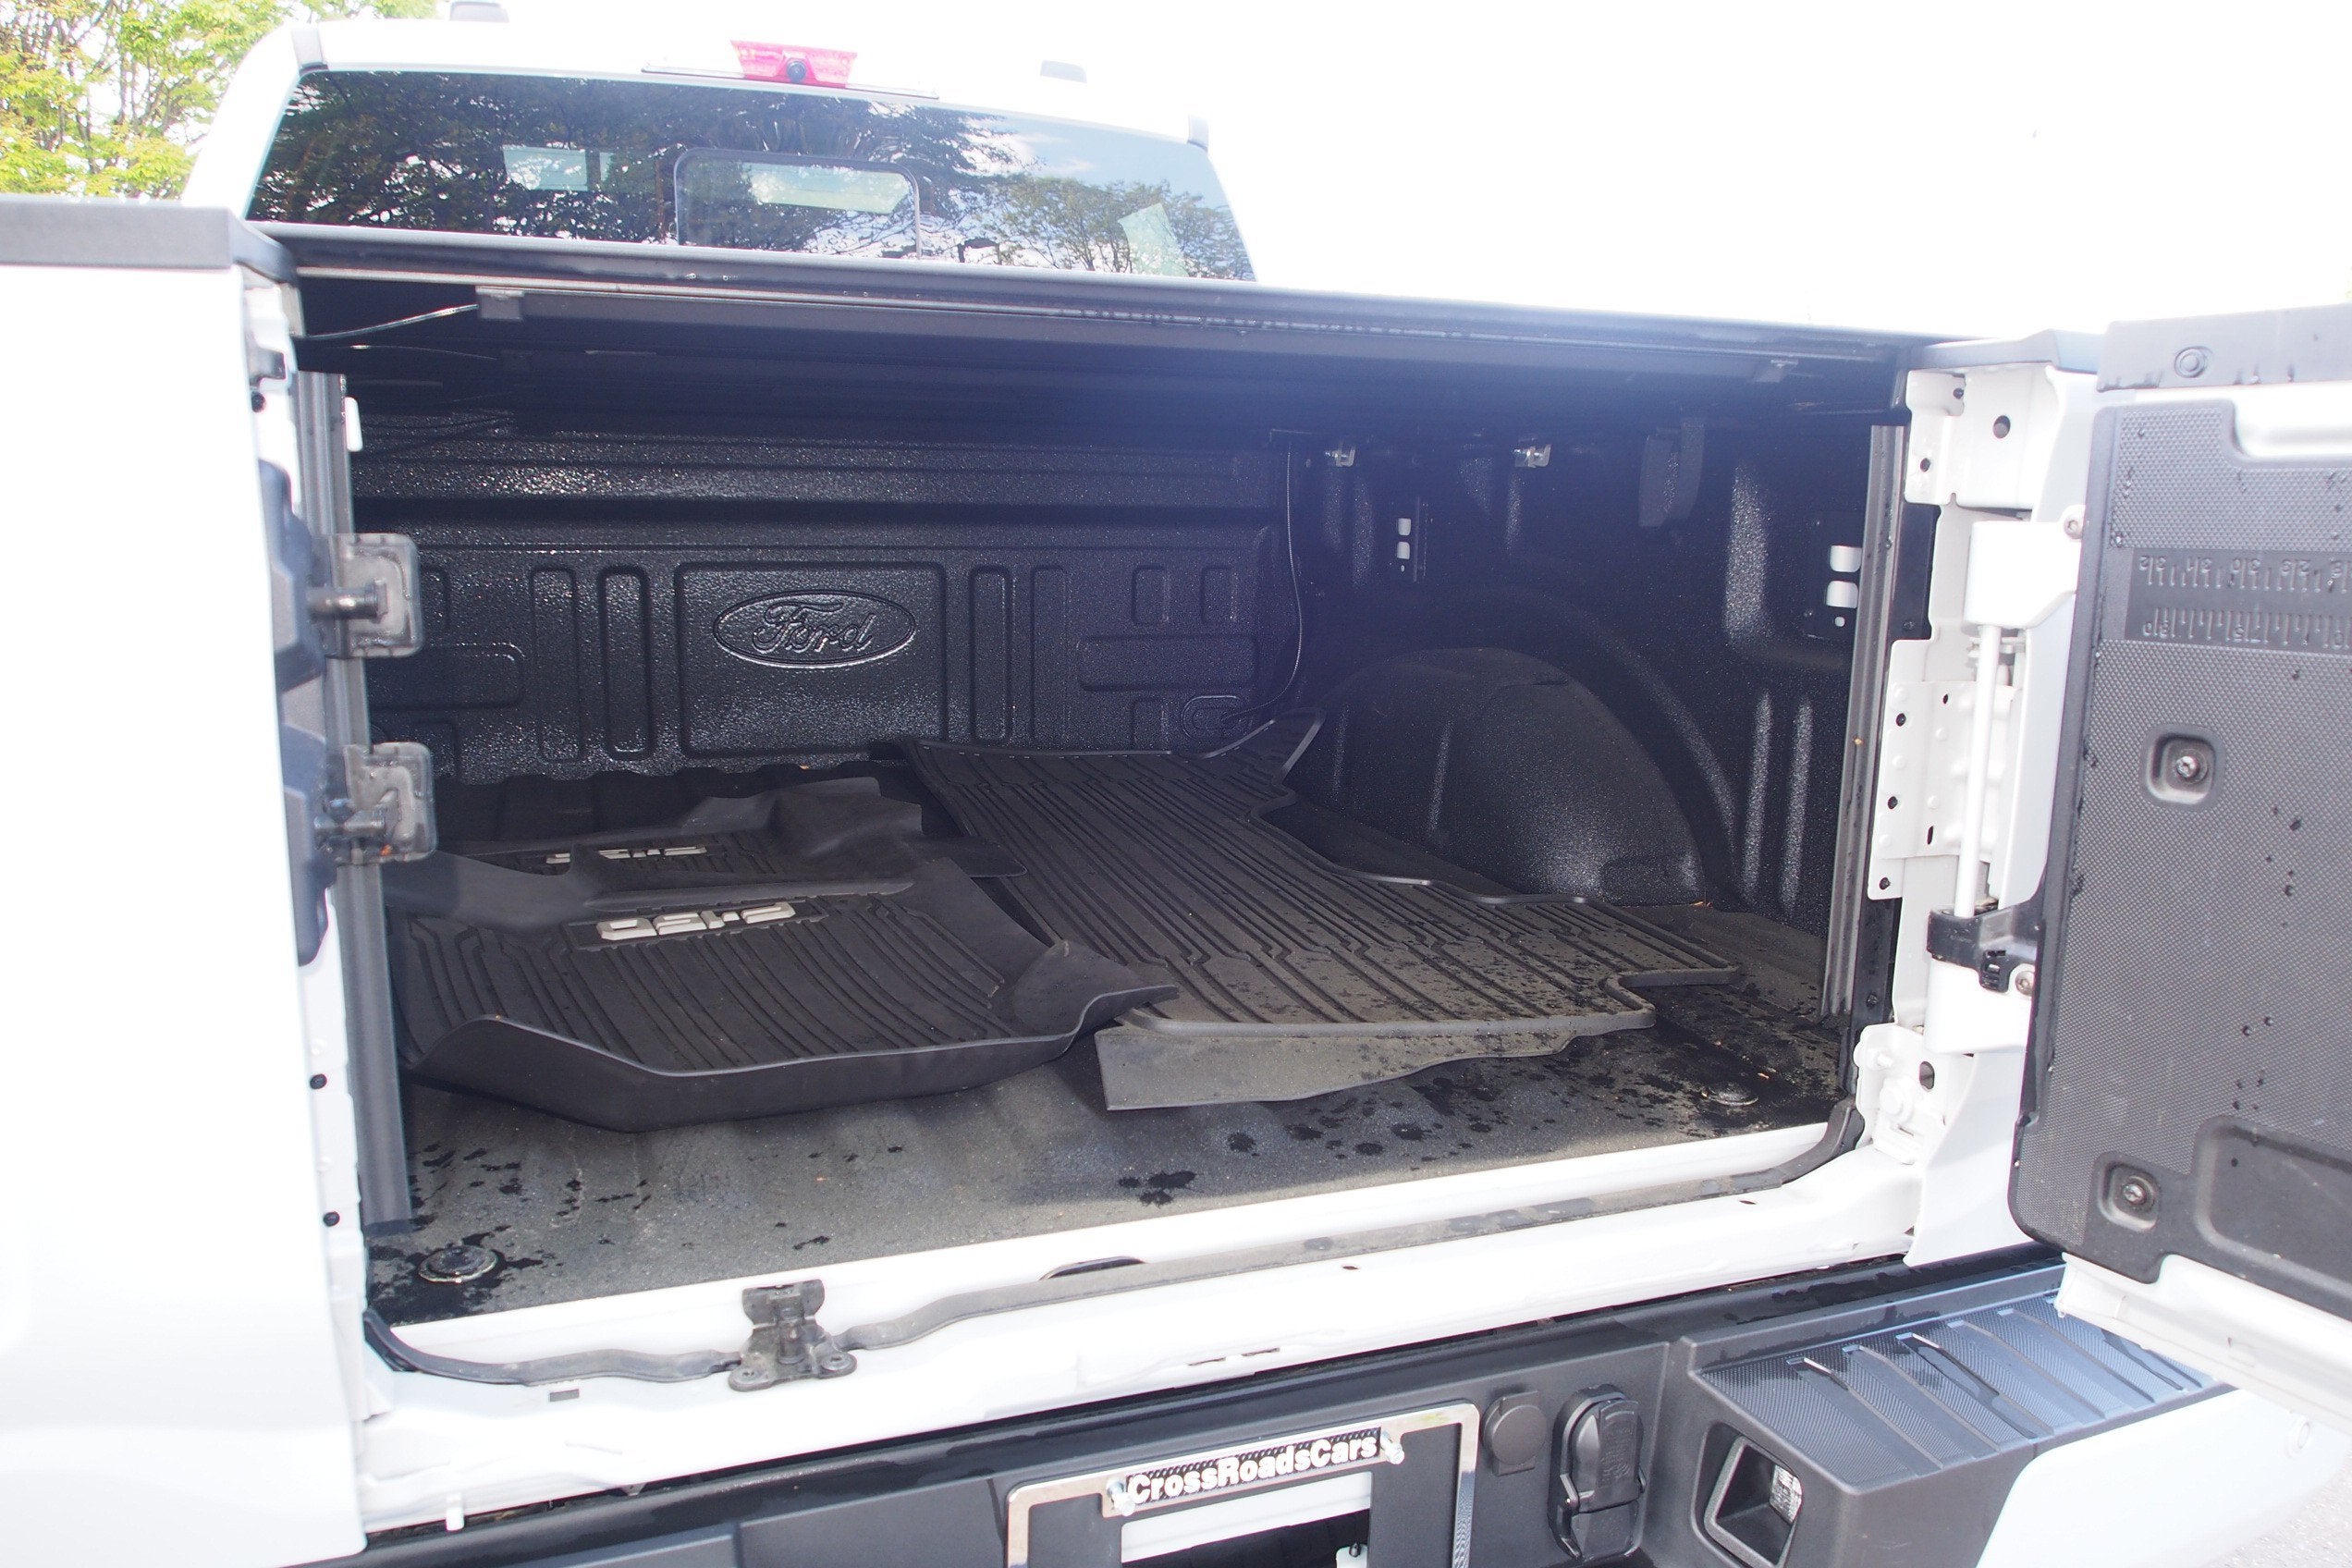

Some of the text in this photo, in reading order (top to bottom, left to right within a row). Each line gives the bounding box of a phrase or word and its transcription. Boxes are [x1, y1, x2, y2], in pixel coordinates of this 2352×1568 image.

[753, 602, 876, 654] Ford
[596, 901, 796, 941] F-150
[1127, 1436, 1378, 1505] CrossRoadsCars
